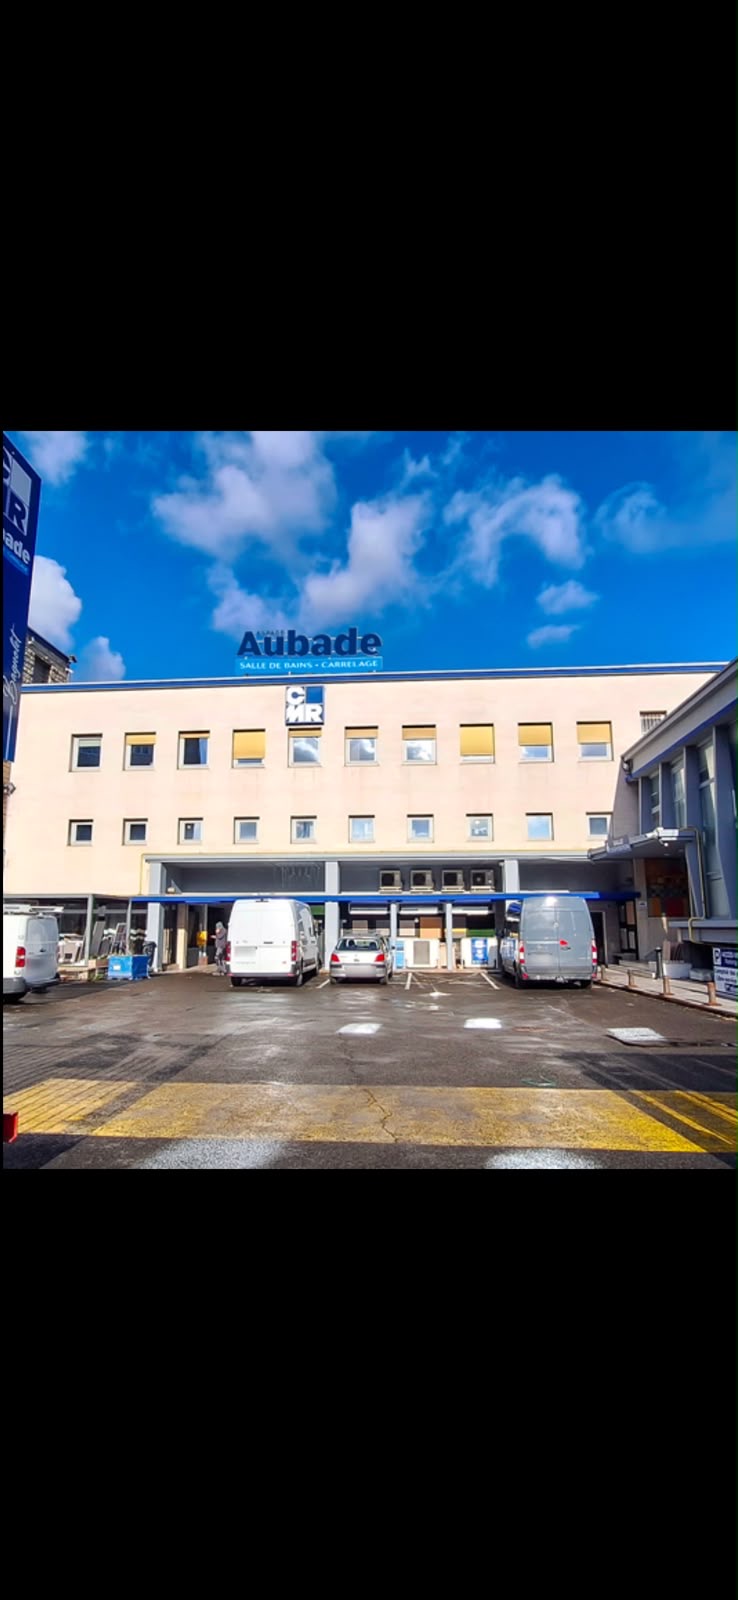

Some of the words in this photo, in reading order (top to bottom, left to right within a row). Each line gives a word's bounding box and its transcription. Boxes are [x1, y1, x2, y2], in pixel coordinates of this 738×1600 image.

[237, 627, 383, 657] Aubade
[284, 661, 313, 669] BAINS
[321, 660, 379, 668] CARRELAGE
